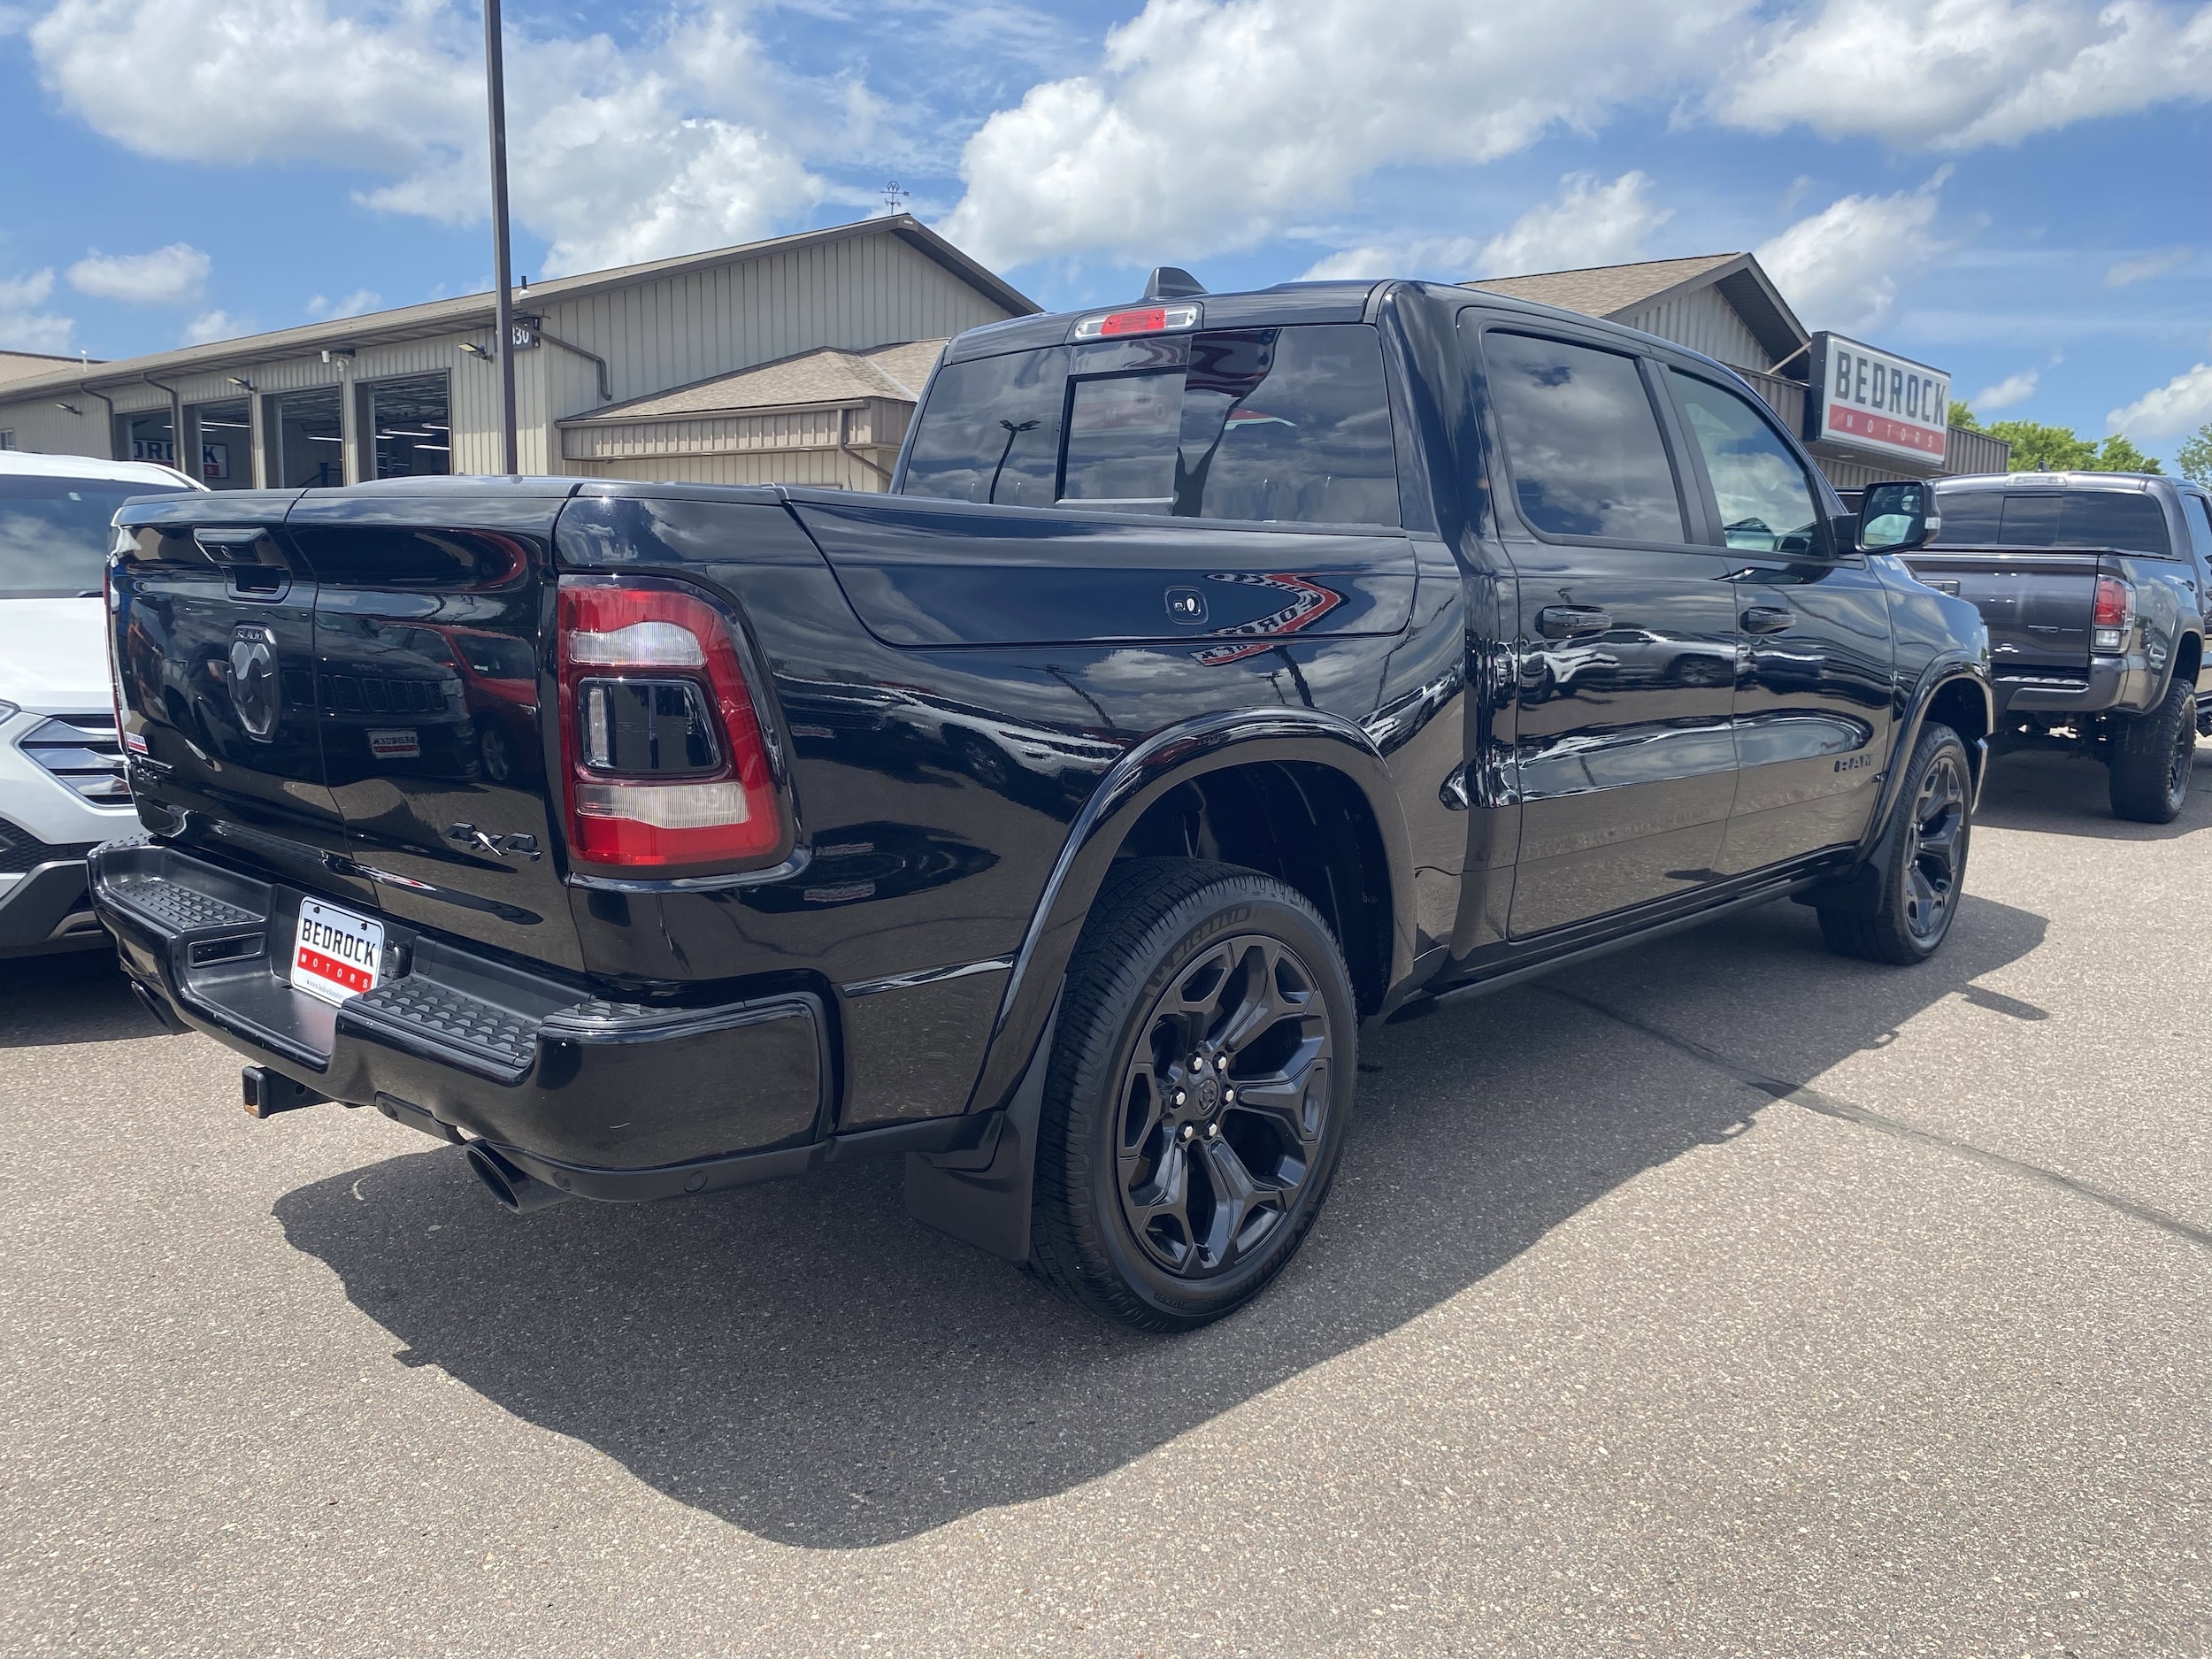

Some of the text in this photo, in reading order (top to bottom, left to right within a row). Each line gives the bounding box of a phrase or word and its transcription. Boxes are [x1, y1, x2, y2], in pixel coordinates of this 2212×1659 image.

[1834, 350, 1946, 426] BEDROCK
[1845, 413, 1934, 448] MOTORS
[235, 630, 263, 641] RAM
[301, 918, 376, 968] BEDROCK
[301, 953, 369, 989] MOTORS
